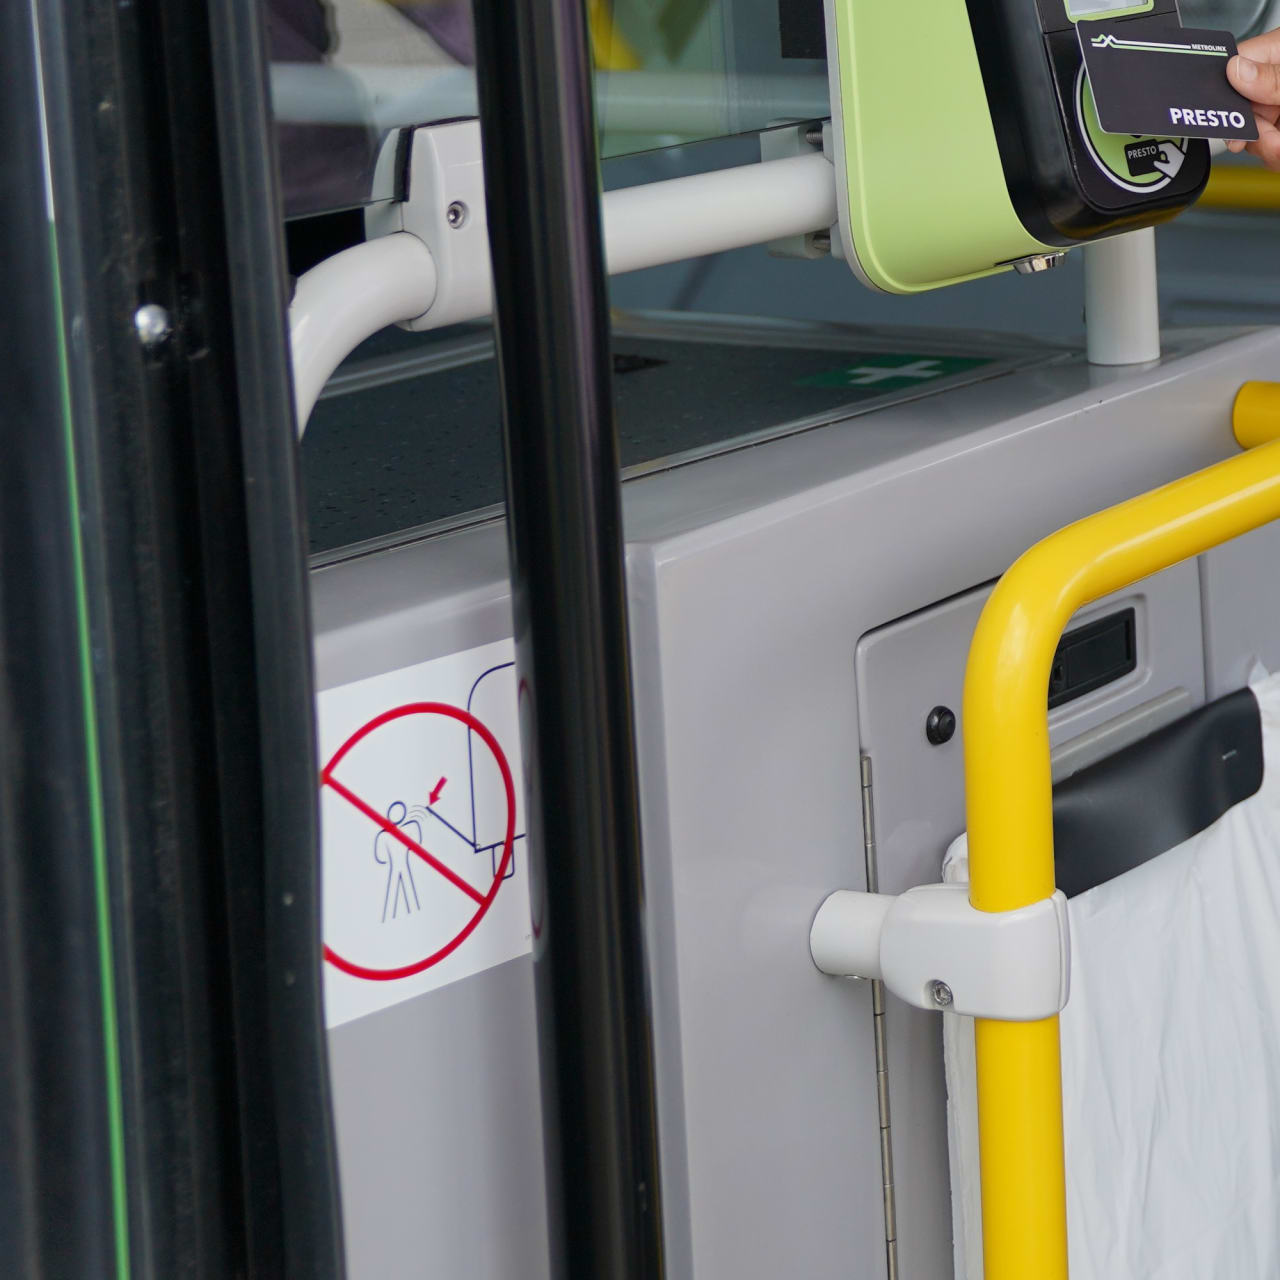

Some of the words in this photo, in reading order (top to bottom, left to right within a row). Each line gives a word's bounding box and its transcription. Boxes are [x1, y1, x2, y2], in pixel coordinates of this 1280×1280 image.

[1191, 44, 1227, 52] METROLINX
[1169, 107, 1246, 129] PRESTO
[1127, 145, 1157, 160] PRESTO
